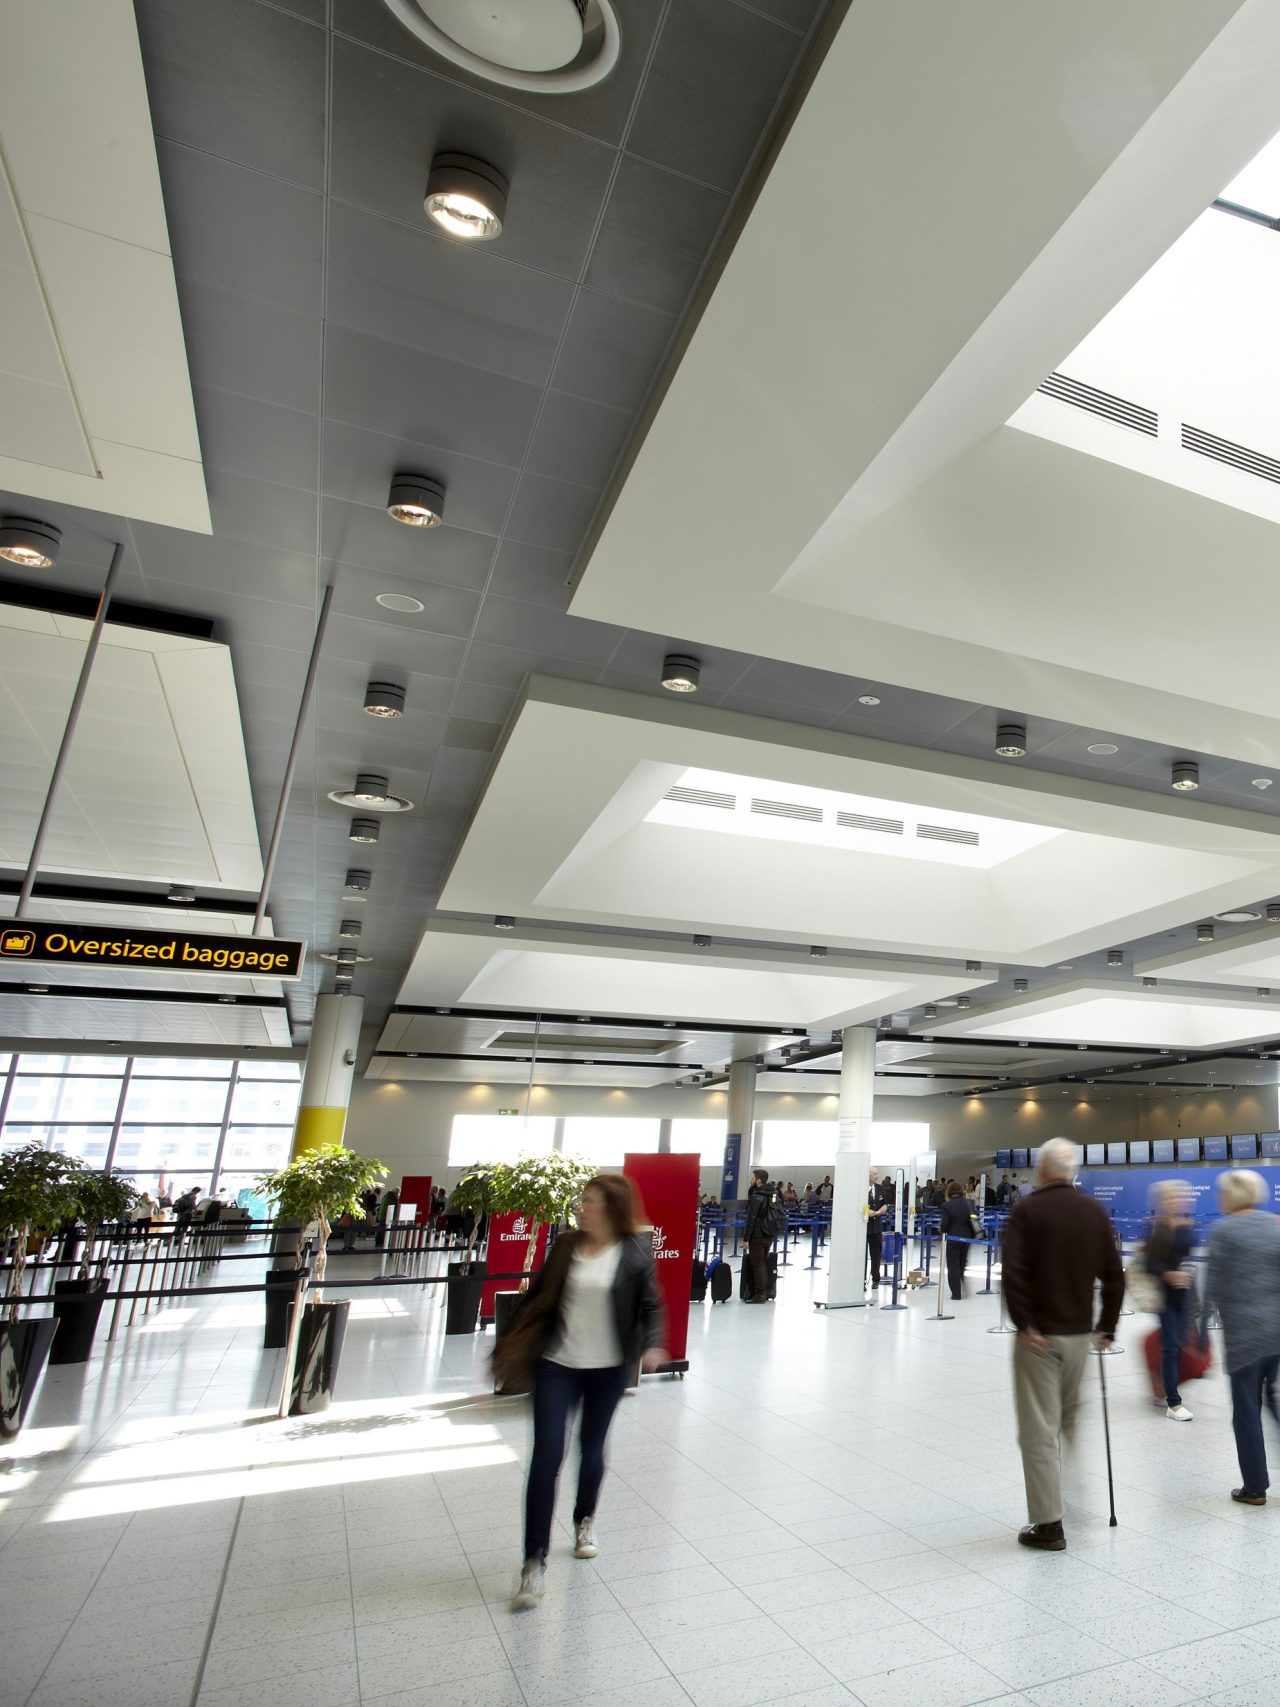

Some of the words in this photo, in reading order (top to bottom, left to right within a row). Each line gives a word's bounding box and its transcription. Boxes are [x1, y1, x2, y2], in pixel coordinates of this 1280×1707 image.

[45, 933, 176, 960] Oversized
[182, 942, 289, 971] baggage
[653, 1249, 680, 1259] rates
